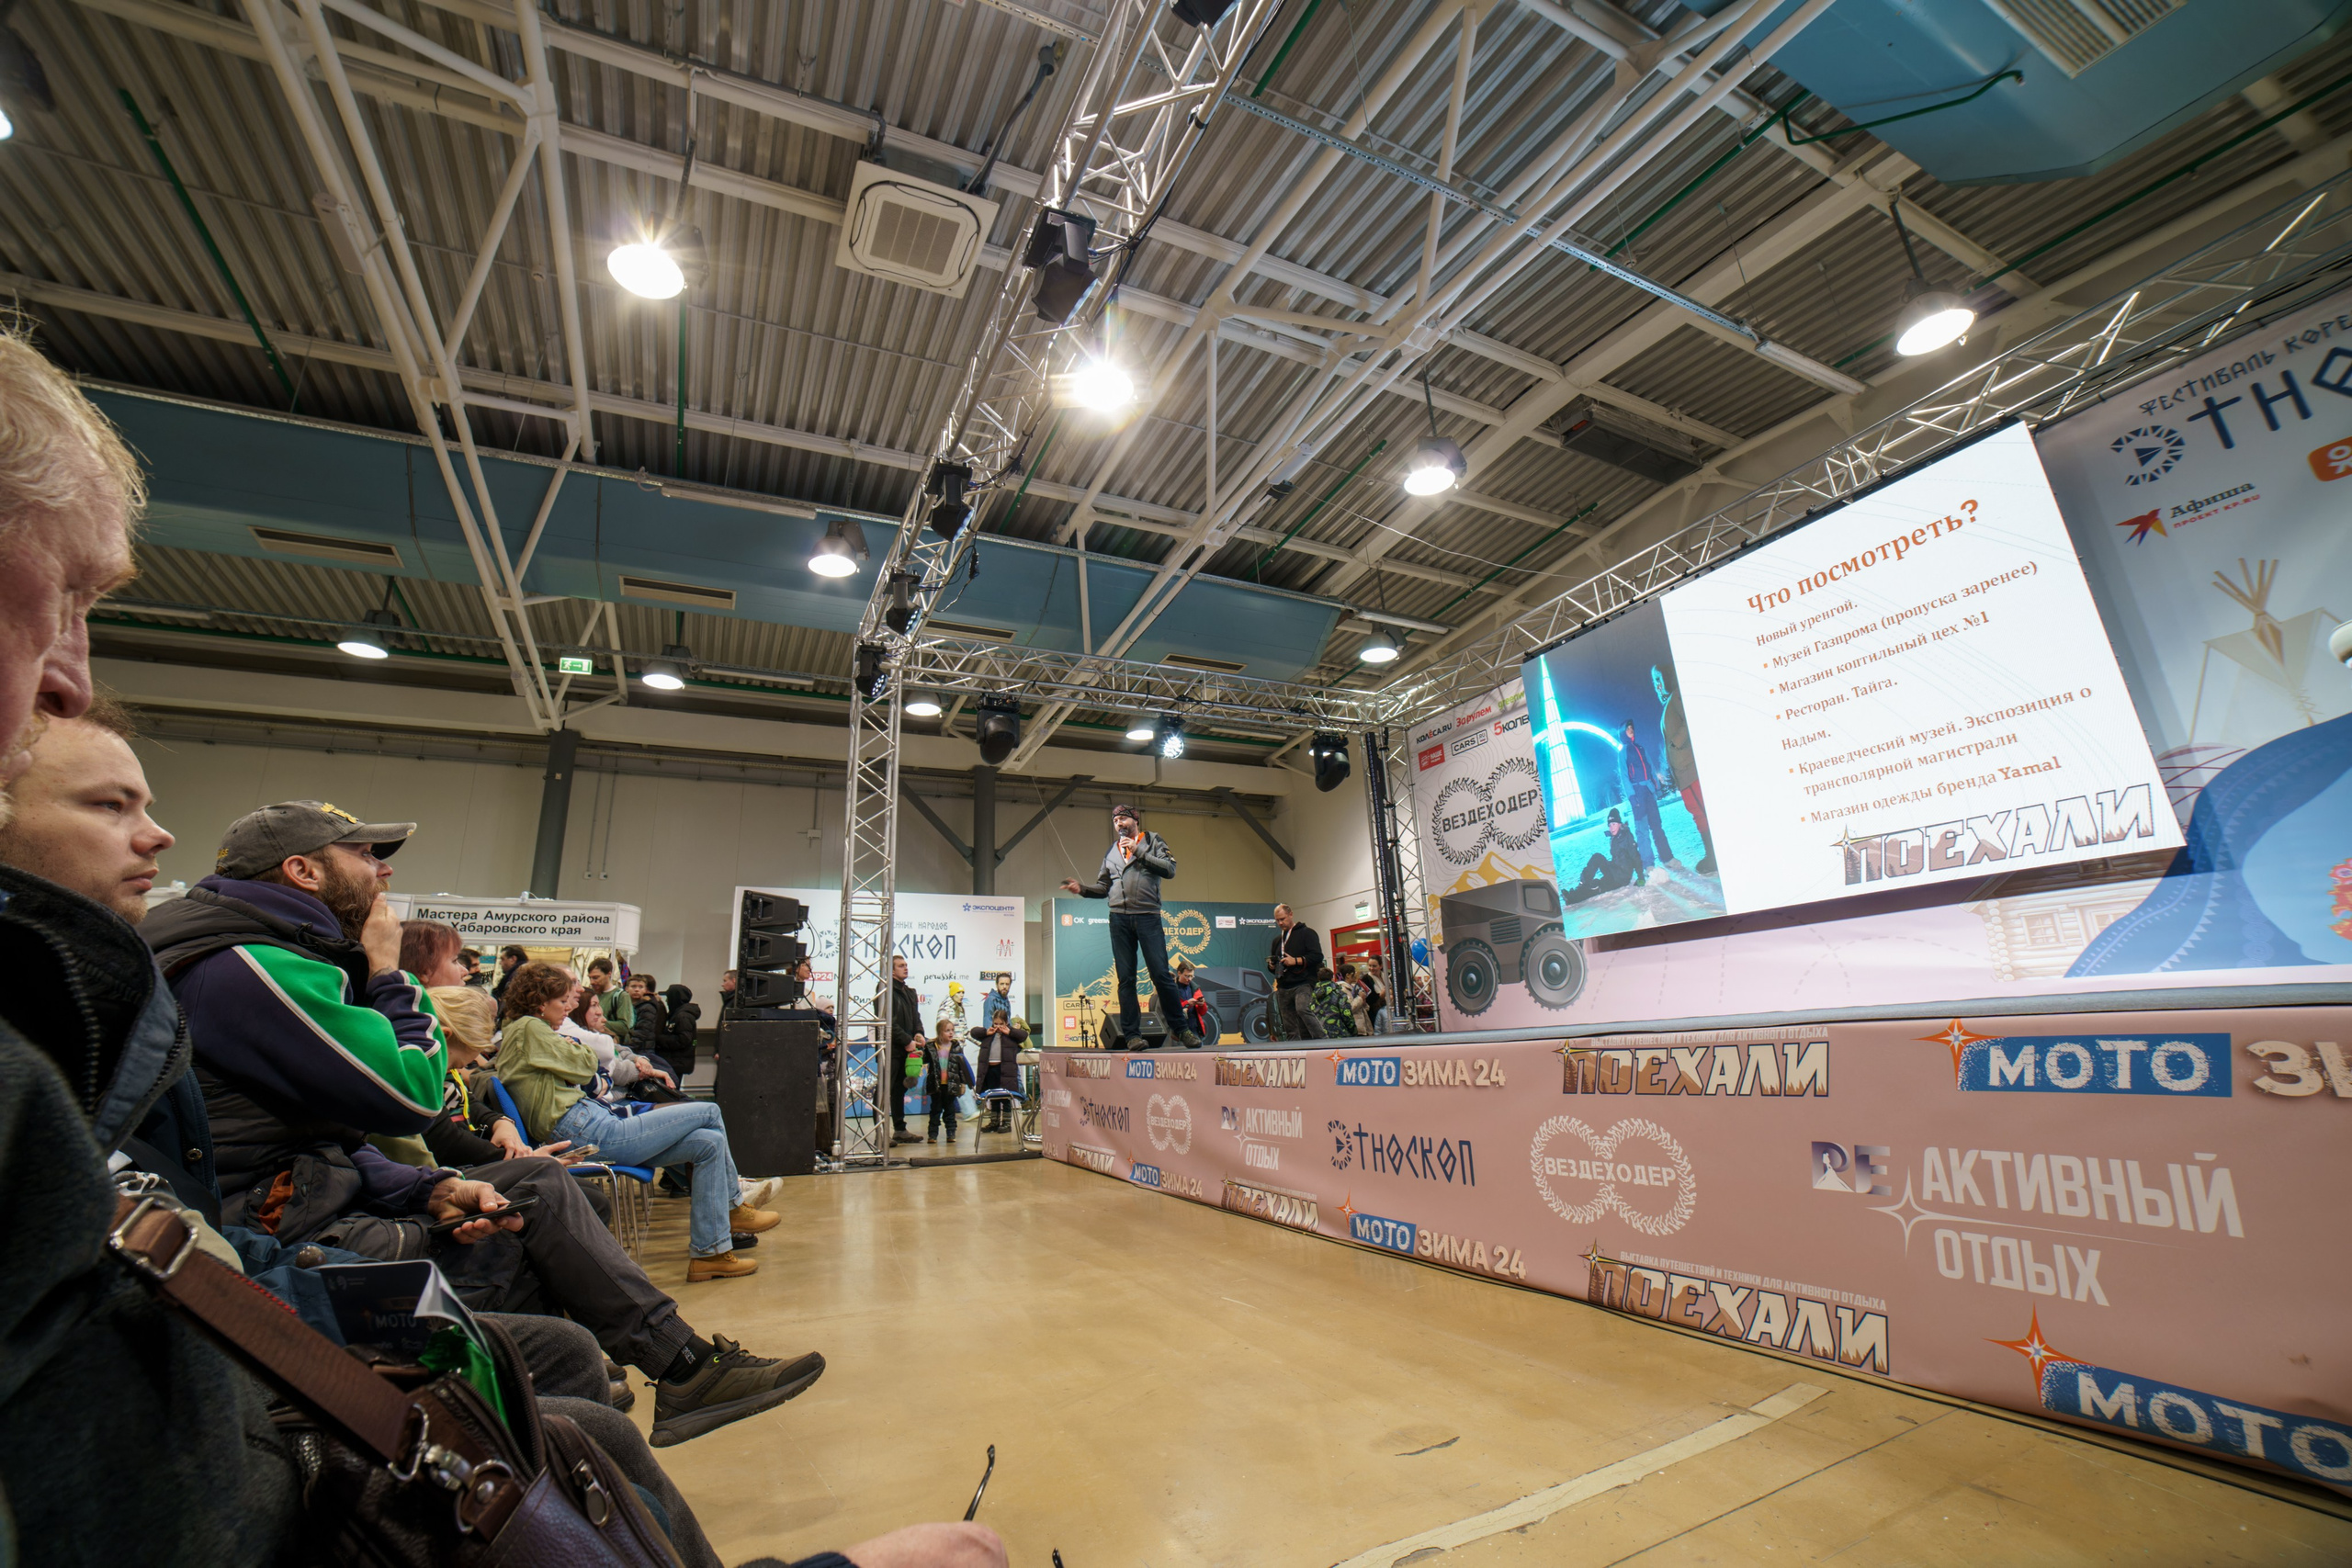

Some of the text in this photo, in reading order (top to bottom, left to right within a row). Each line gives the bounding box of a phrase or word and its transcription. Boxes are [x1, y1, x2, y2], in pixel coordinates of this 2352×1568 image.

[2283, 314, 2352, 355] КОРЕ
[2170, 483, 2256, 519] Афиша
[2173, 508, 2220, 528] ПРОЕКТ
[1747, 499, 1978, 614] Что посмотреть?
[1757, 600, 1858, 646] Новый уренгой.
[1772, 561, 2037, 669] Музей Газпрома (пропуска заренее)
[1780, 611, 1989, 694] Магазин коптильный цех №1
[1786, 677, 1897, 721] Ресторан. Тайга.
[1453, 739, 1476, 751] CARS
[1781, 729, 1831, 750] Надым.
[1799, 687, 2092, 775] Краеведческий музей. Экспозиция о
[1804, 733, 2018, 796] трансполярной магистрали
[1442, 788, 1539, 833] ВЕЗДЕХОДЕР
[1811, 756, 2062, 824] Магазин одежды бренда Yamal
[1844, 783, 2154, 886] ПОЕХАЛИ
[417, 908, 610, 924] Мастера Амурского района
[451, 921, 582, 936] Хабаровского края
[918, 922, 948, 931] НАРОДОВ
[1162, 927, 1204, 936] ДЕХОДЕР
[1590, 1037, 1625, 1047] ВЫСТАВКА
[1677, 1033, 1681, 1043] И
[1682, 1032, 1716, 1043] ТЕХНИКИ
[1717, 1031, 1736, 1043] ДЛЯ
[1736, 1028, 1786, 1041] АКТИВНОГО
[1787, 1026, 1828, 1039] ОТДЫХА
[1066, 1058, 1111, 1079] ПОЕХАЛИ
[1128, 1062, 1197, 1081] МОТО ЗИМА 24
[1215, 1057, 1306, 1089] ПОЕХАЛИ
[1341, 1058, 1505, 1088] МОТО ЗИМА 24
[1562, 1041, 1829, 1098] ПОЕХАЛИ
[1988, 1039, 2211, 1092] МОТО
[1149, 1115, 1188, 1130] ВЕЗДЕХОДЕР
[1245, 1106, 1303, 1139] АКТИВНЫЙ
[1245, 1145, 1279, 1170] ОТДЫХ
[1544, 1156, 1677, 1188] ВЕЗДЕХОДЕР
[1134, 1165, 1203, 1198] МОТО ЗИМА 24
[1922, 1146, 2245, 1238] АКТИВНЫЙ
[1221, 1184, 1319, 1232] ПОЕХАЛИ
[1356, 1215, 1527, 1280] МОТО ЗИМА 24
[1934, 1228, 2110, 1307] ОТДЫХ
[1621, 1251, 1886, 1312] ВЫСТАВКА ПУТЕШЕСТВИЙ И ТЕХНИКИ ДЛЯ АКТИВНОГО ОТДЫХА
[1588, 1262, 1890, 1375] ПОЕХАЛИ
[2078, 1371, 2352, 1483] МОТО
